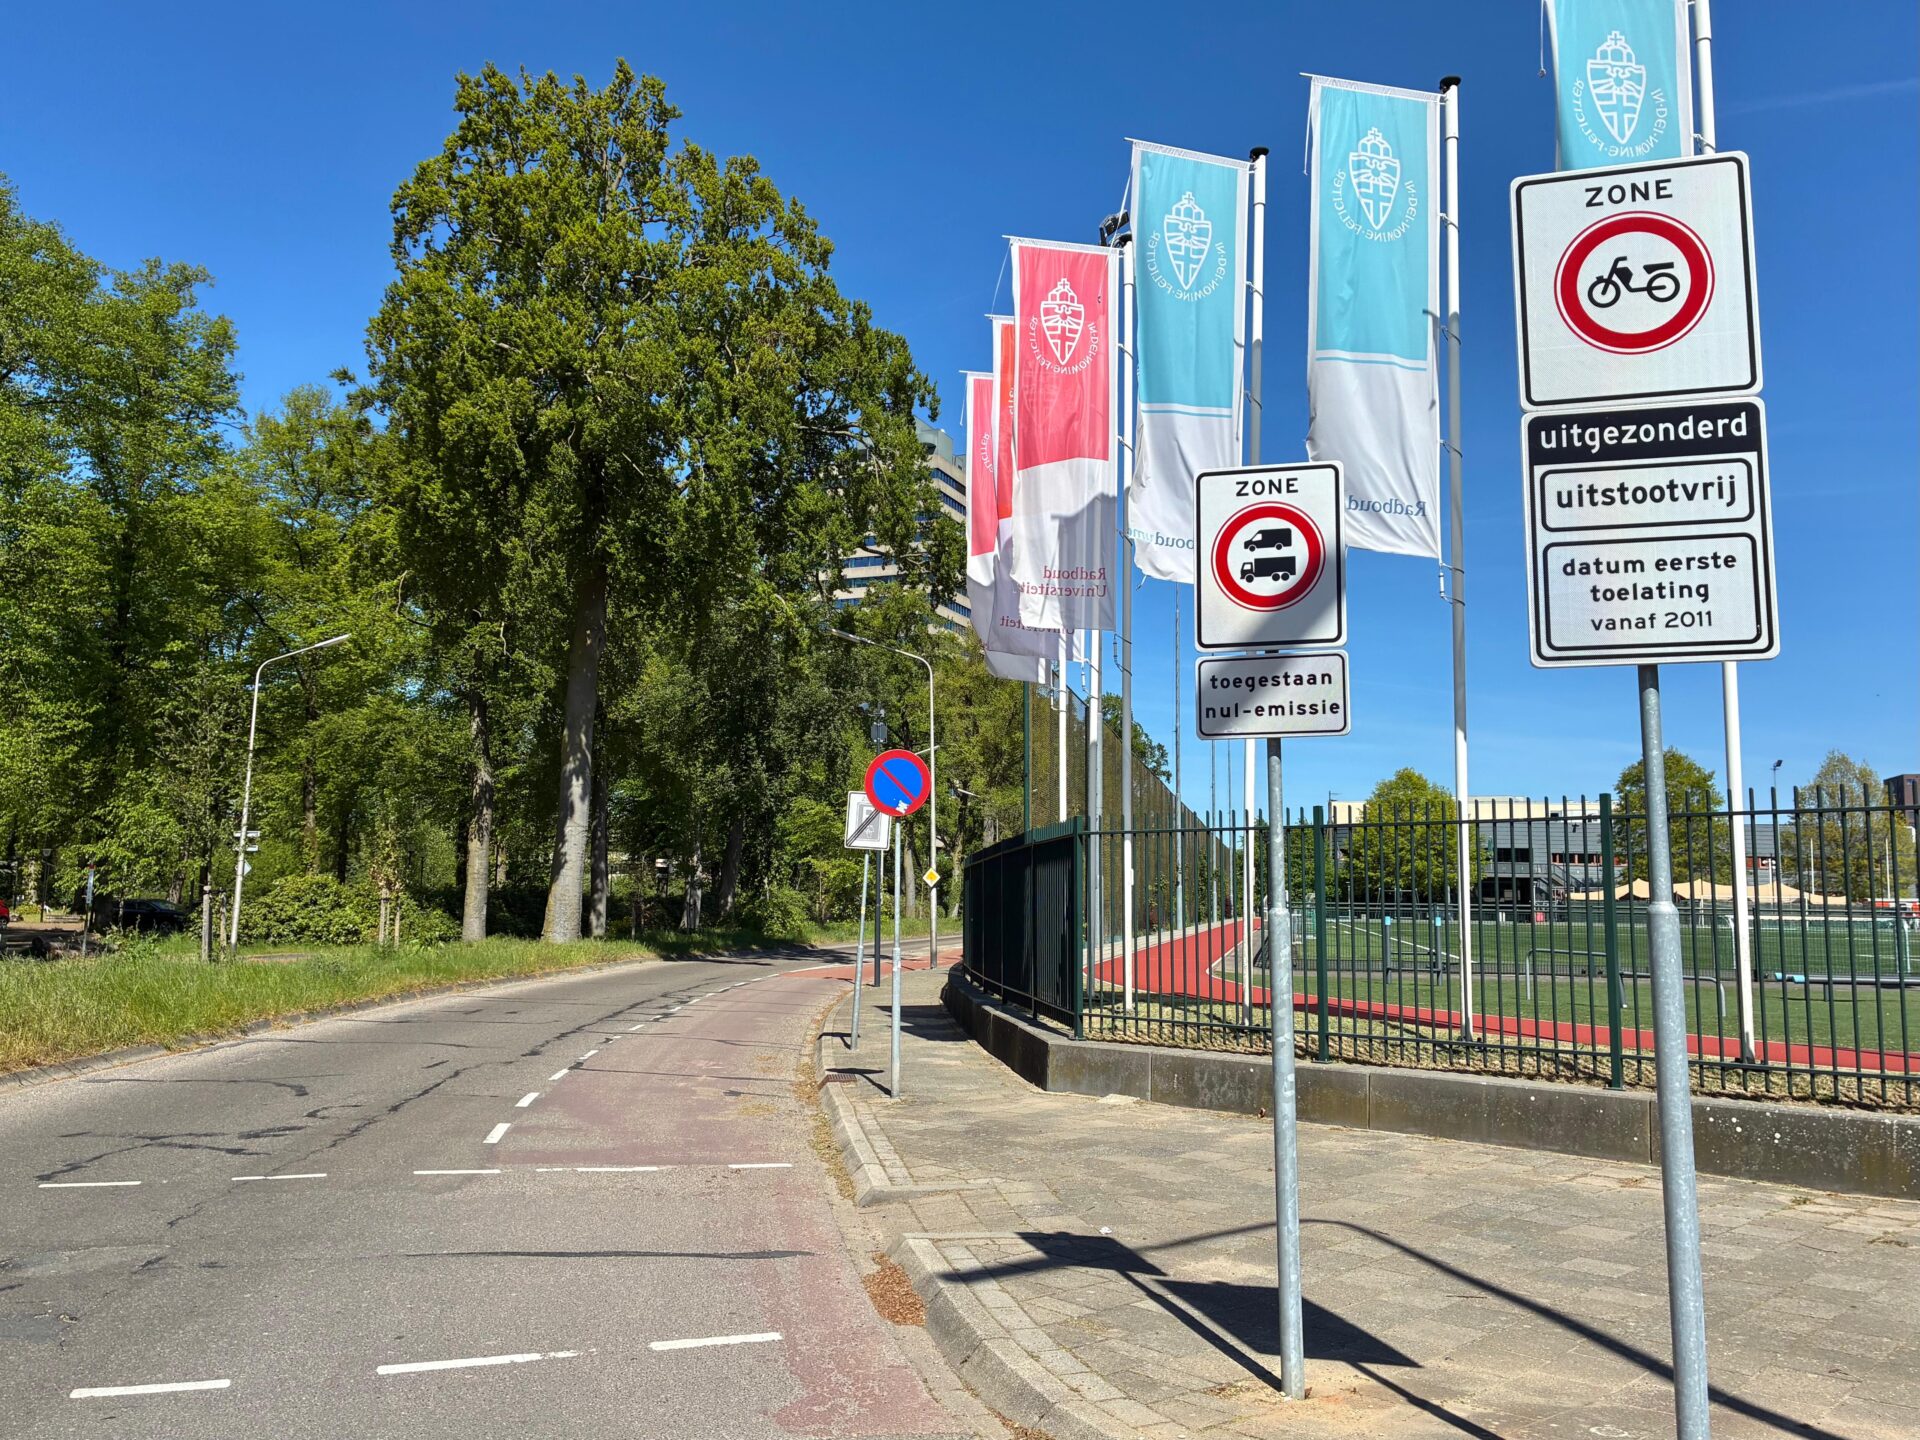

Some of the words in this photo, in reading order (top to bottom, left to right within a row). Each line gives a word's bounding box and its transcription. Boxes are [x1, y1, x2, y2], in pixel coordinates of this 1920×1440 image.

[1584, 178, 1673, 208] ZONE
[1540, 411, 1748, 454] uitgezonderd
[1235, 477, 1299, 497] ZONE
[1556, 474, 1736, 508] uitstootvrij
[1562, 556, 1646, 577] datum
[1654, 551, 1737, 573] eerste
[1590, 580, 1709, 604] toelating
[1590, 612, 1657, 631] vanaf
[1664, 610, 1713, 629] 2011
[1210, 671, 1333, 693] toegestaan
[1205, 699, 1341, 719] nul-emissie
